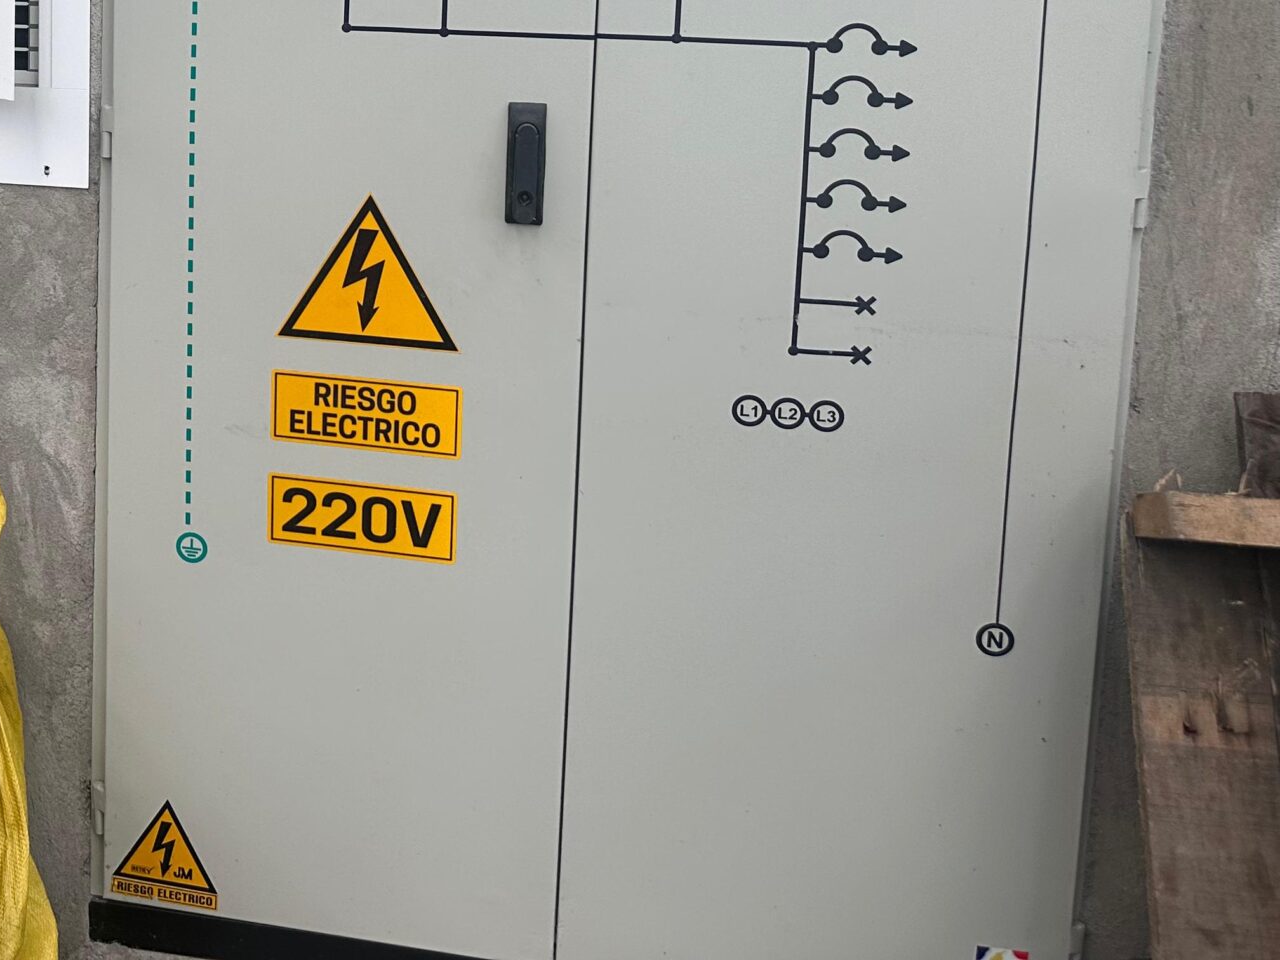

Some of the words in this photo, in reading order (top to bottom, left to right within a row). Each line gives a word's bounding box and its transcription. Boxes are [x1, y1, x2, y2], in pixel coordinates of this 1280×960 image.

[314, 382, 417, 416] RIESGO
[740, 404, 758, 418] L1
[778, 407, 798, 420] L2
[816, 410, 836, 423] L3
[289, 409, 441, 448] ELECTRICO
[282, 487, 442, 548] 220V
[987, 630, 1004, 649] N
[173, 867, 193, 880] JM
[117, 880, 154, 896] RIESGO
[157, 888, 213, 906] ELECTRICO
